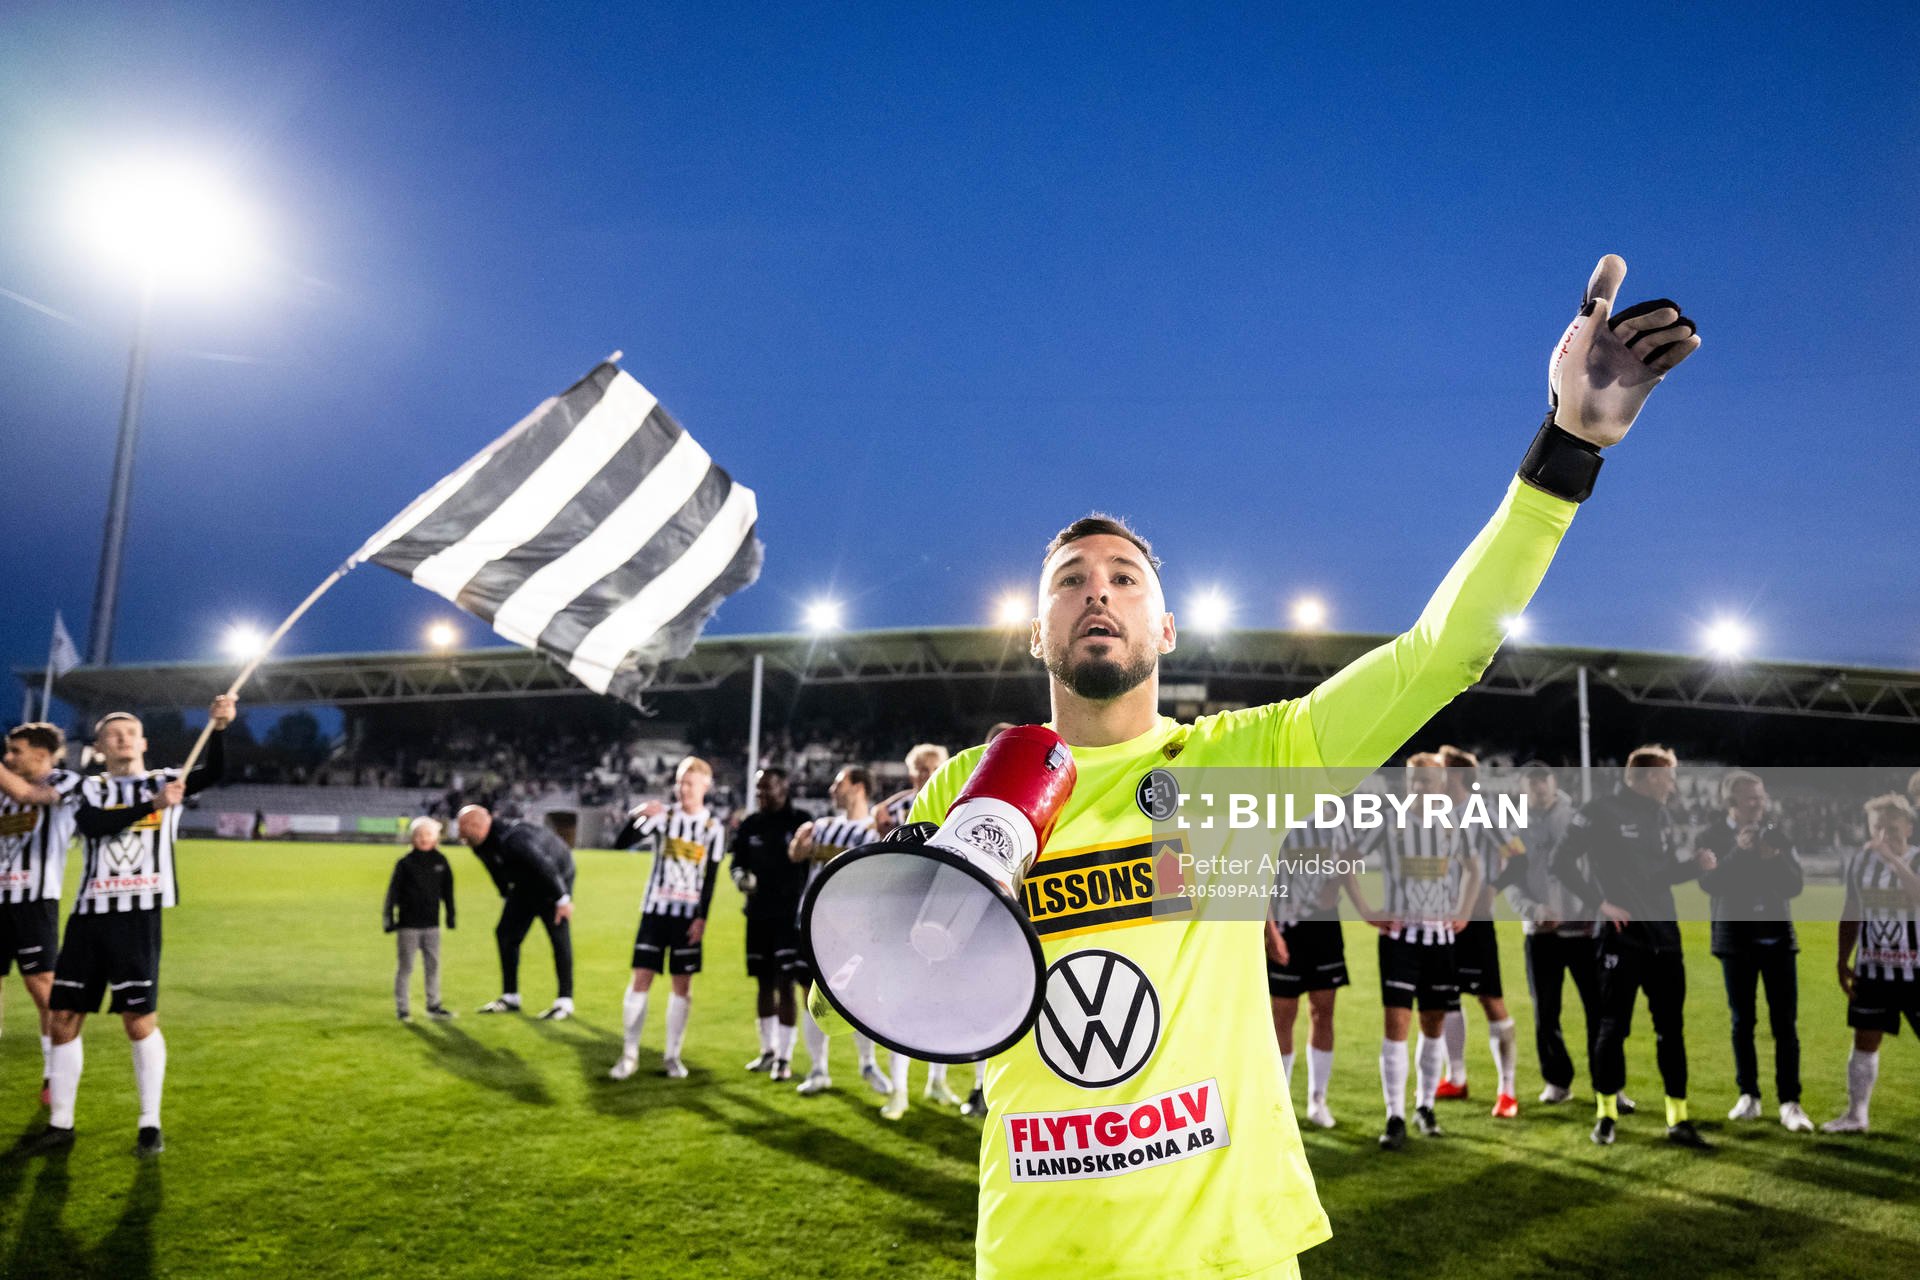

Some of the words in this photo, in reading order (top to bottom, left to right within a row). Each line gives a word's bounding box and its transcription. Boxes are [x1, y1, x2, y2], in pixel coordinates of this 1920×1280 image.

[1011, 1086, 1209, 1153] FLYTGOLV
[1027, 1140, 1181, 1177] LANDSKRONA
[1187, 1128, 1215, 1151] AB
